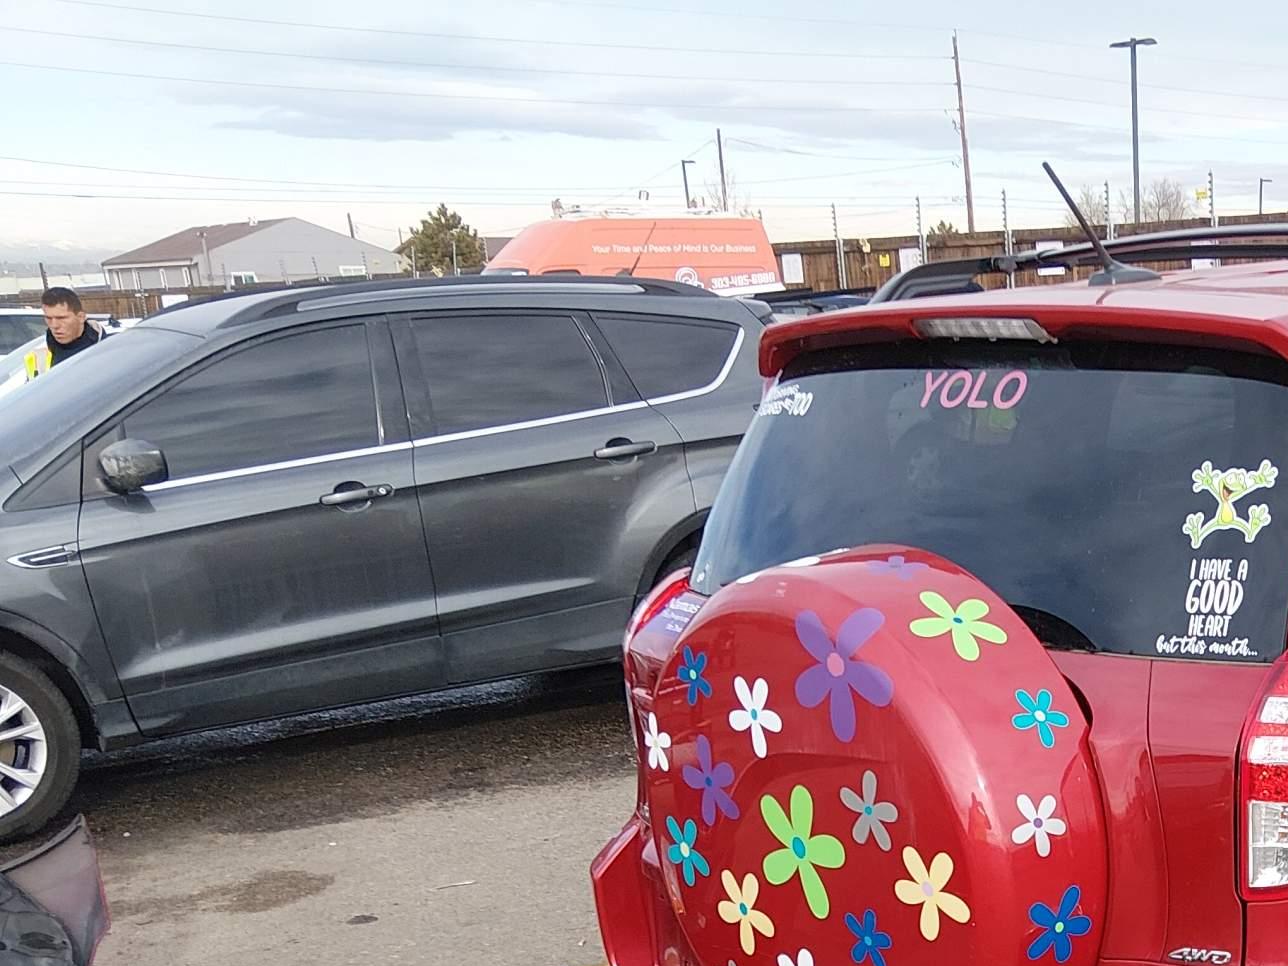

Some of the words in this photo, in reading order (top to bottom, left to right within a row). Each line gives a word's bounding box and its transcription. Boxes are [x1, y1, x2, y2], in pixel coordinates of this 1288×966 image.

[591, 244, 610, 254] Your
[612, 244, 631, 253] Time
[632, 244, 648, 253] and
[649, 244, 672, 253] Peace
[673, 243, 682, 253] of
[683, 243, 701, 252] Mind
[710, 243, 724, 252] Our
[726, 243, 757, 252] Business
[920, 369, 1028, 409] YOLO
[1189, 558, 1198, 580] I
[1198, 558, 1233, 581] HAVE
[1236, 558, 1249, 581] A
[1185, 579, 1244, 616] GOOD
[1187, 614, 1232, 637] HEART
[1156, 634, 1180, 654] but
[1179, 635, 1207, 655] this
[1168, 947, 1232, 966] 4WD
